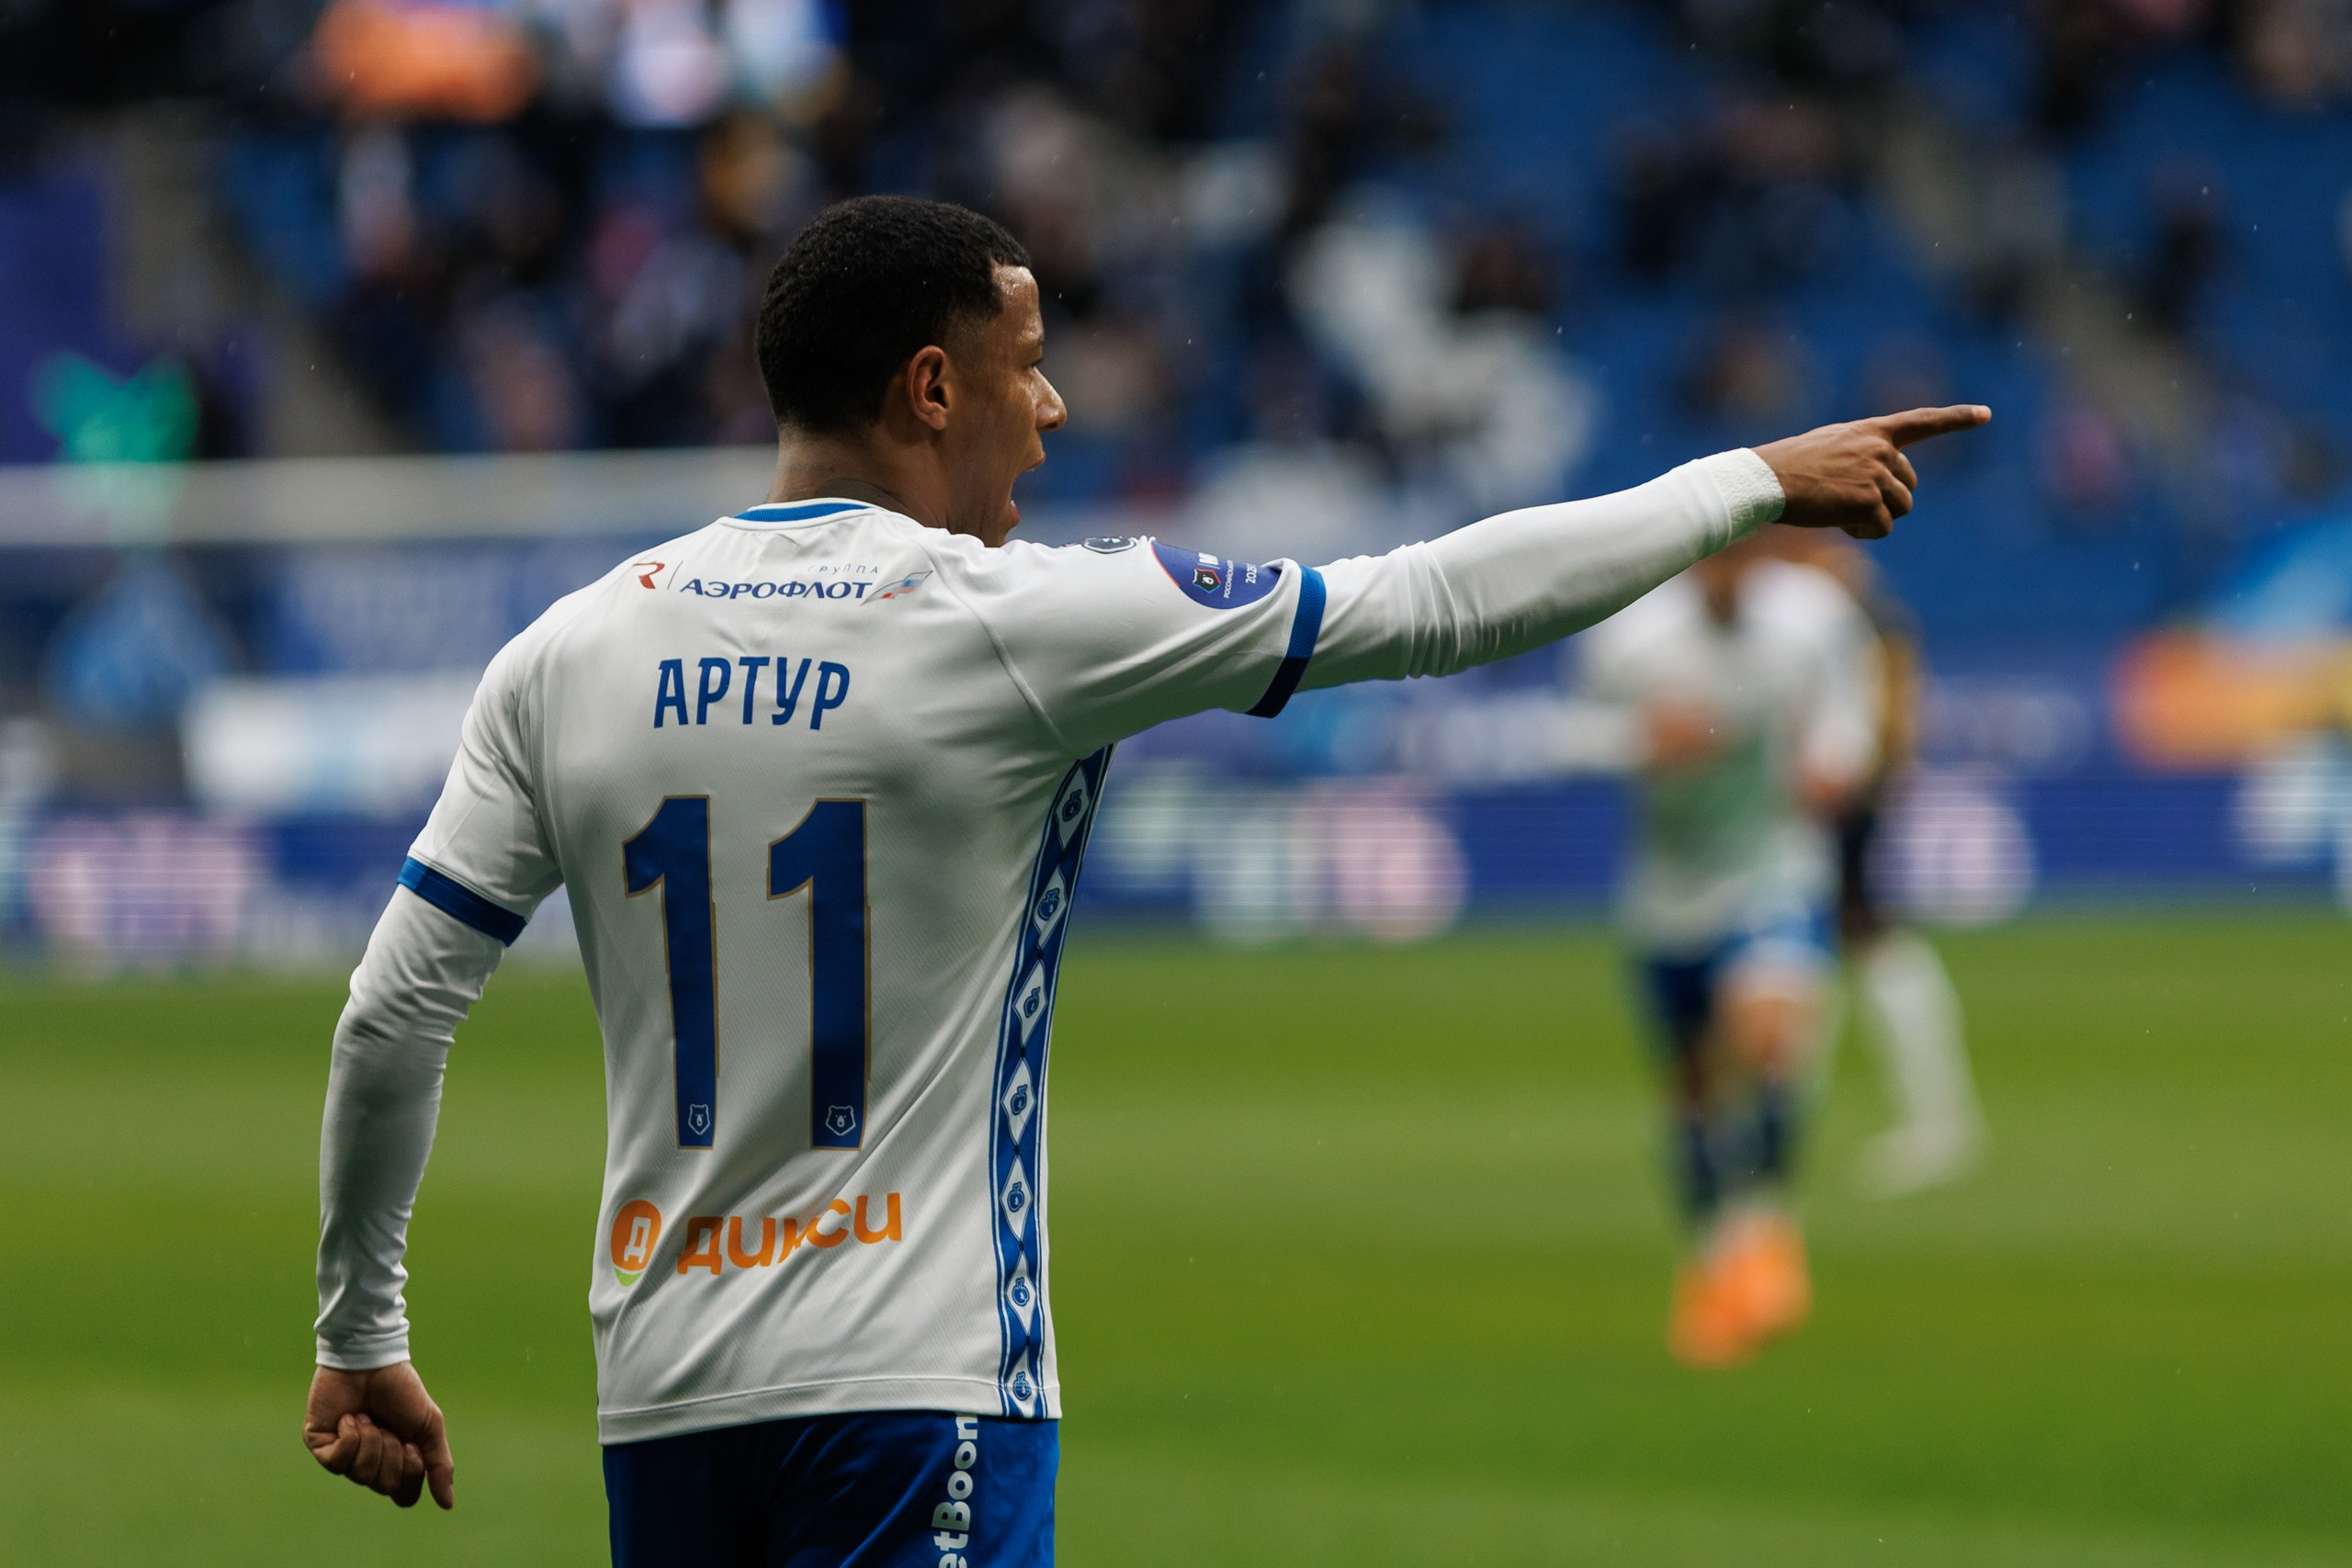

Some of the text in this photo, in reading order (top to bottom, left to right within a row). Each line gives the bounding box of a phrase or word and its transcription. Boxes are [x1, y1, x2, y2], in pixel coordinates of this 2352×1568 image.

[680, 579, 873, 600] АЭРОФЛОТ
[653, 656, 850, 730] АРТУР
[622, 795, 871, 1150] 11
